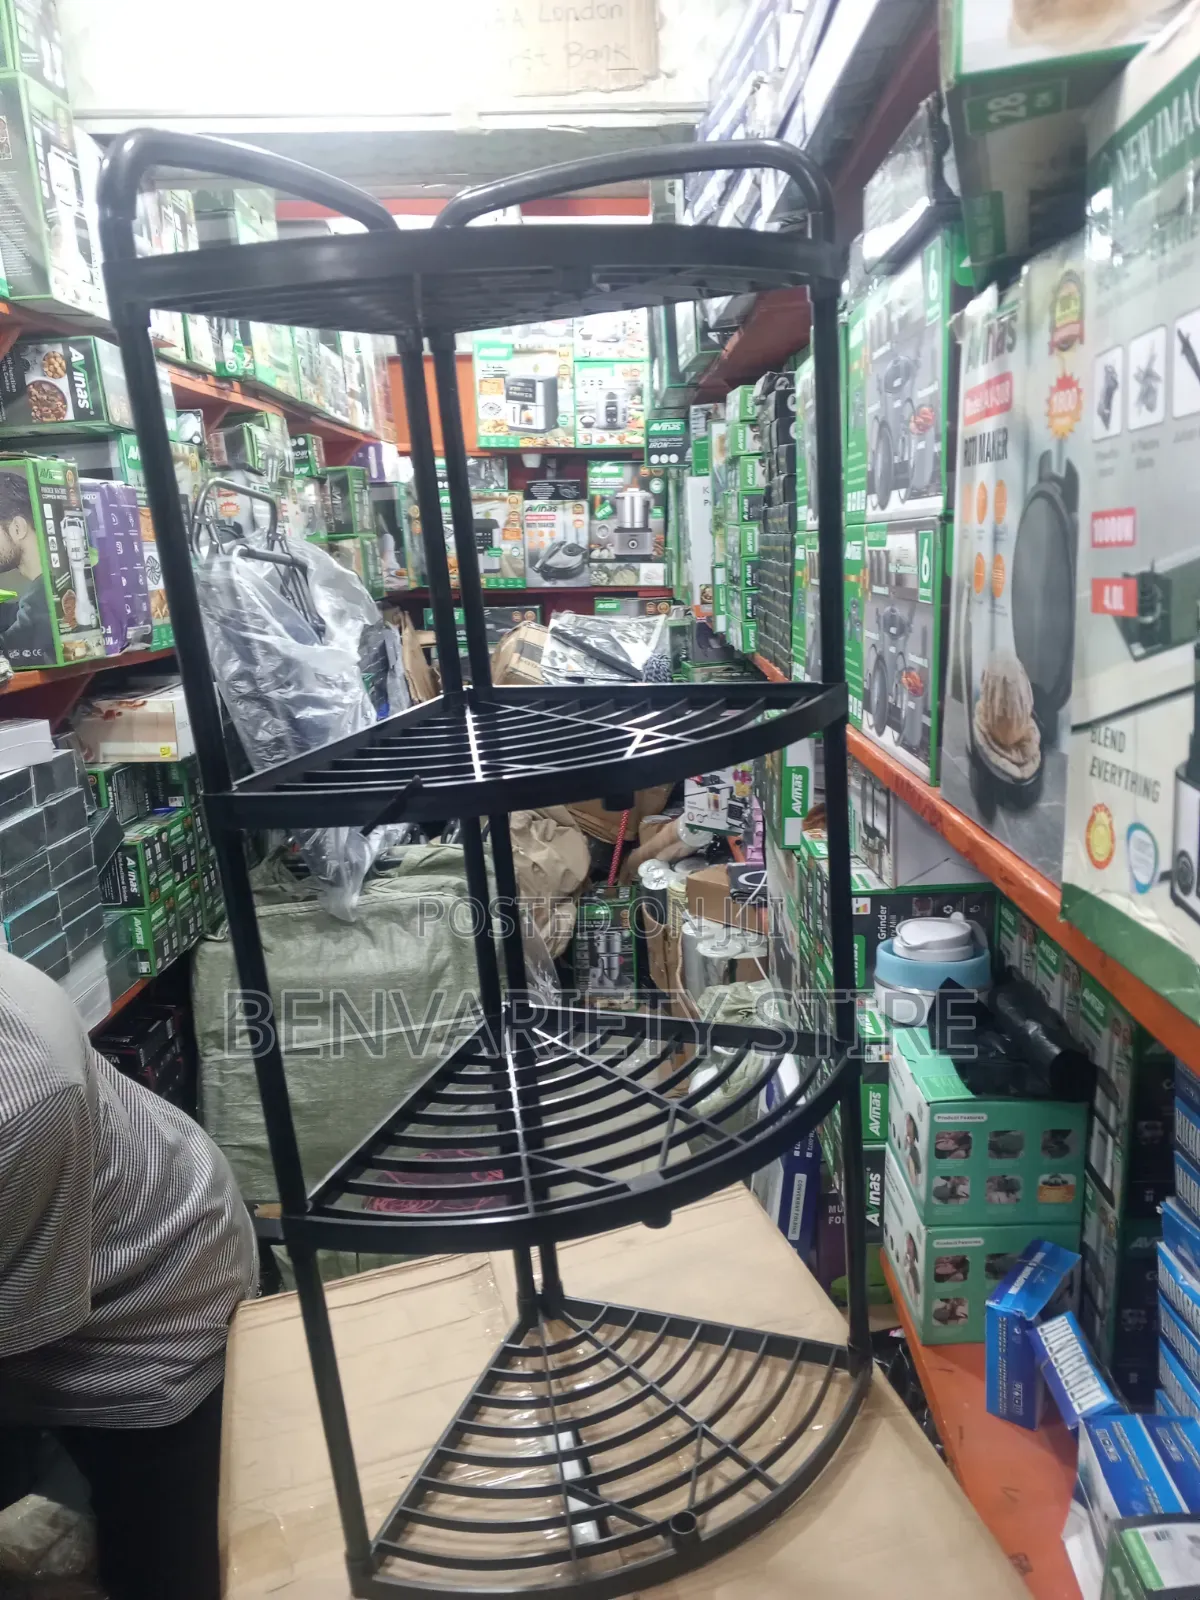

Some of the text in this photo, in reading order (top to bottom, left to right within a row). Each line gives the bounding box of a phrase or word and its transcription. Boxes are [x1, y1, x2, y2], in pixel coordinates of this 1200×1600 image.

[987, 91, 1028, 124] 28
[927, 249, 938, 299] 6
[978, 428, 1009, 466] MAKER
[921, 537, 931, 584] 6
[1090, 726, 1126, 753] BLEND
[1088, 755, 1161, 804] EVERYTHING
[877, 905, 888, 940] Grinder
[828, 1205, 843, 1213] MU
